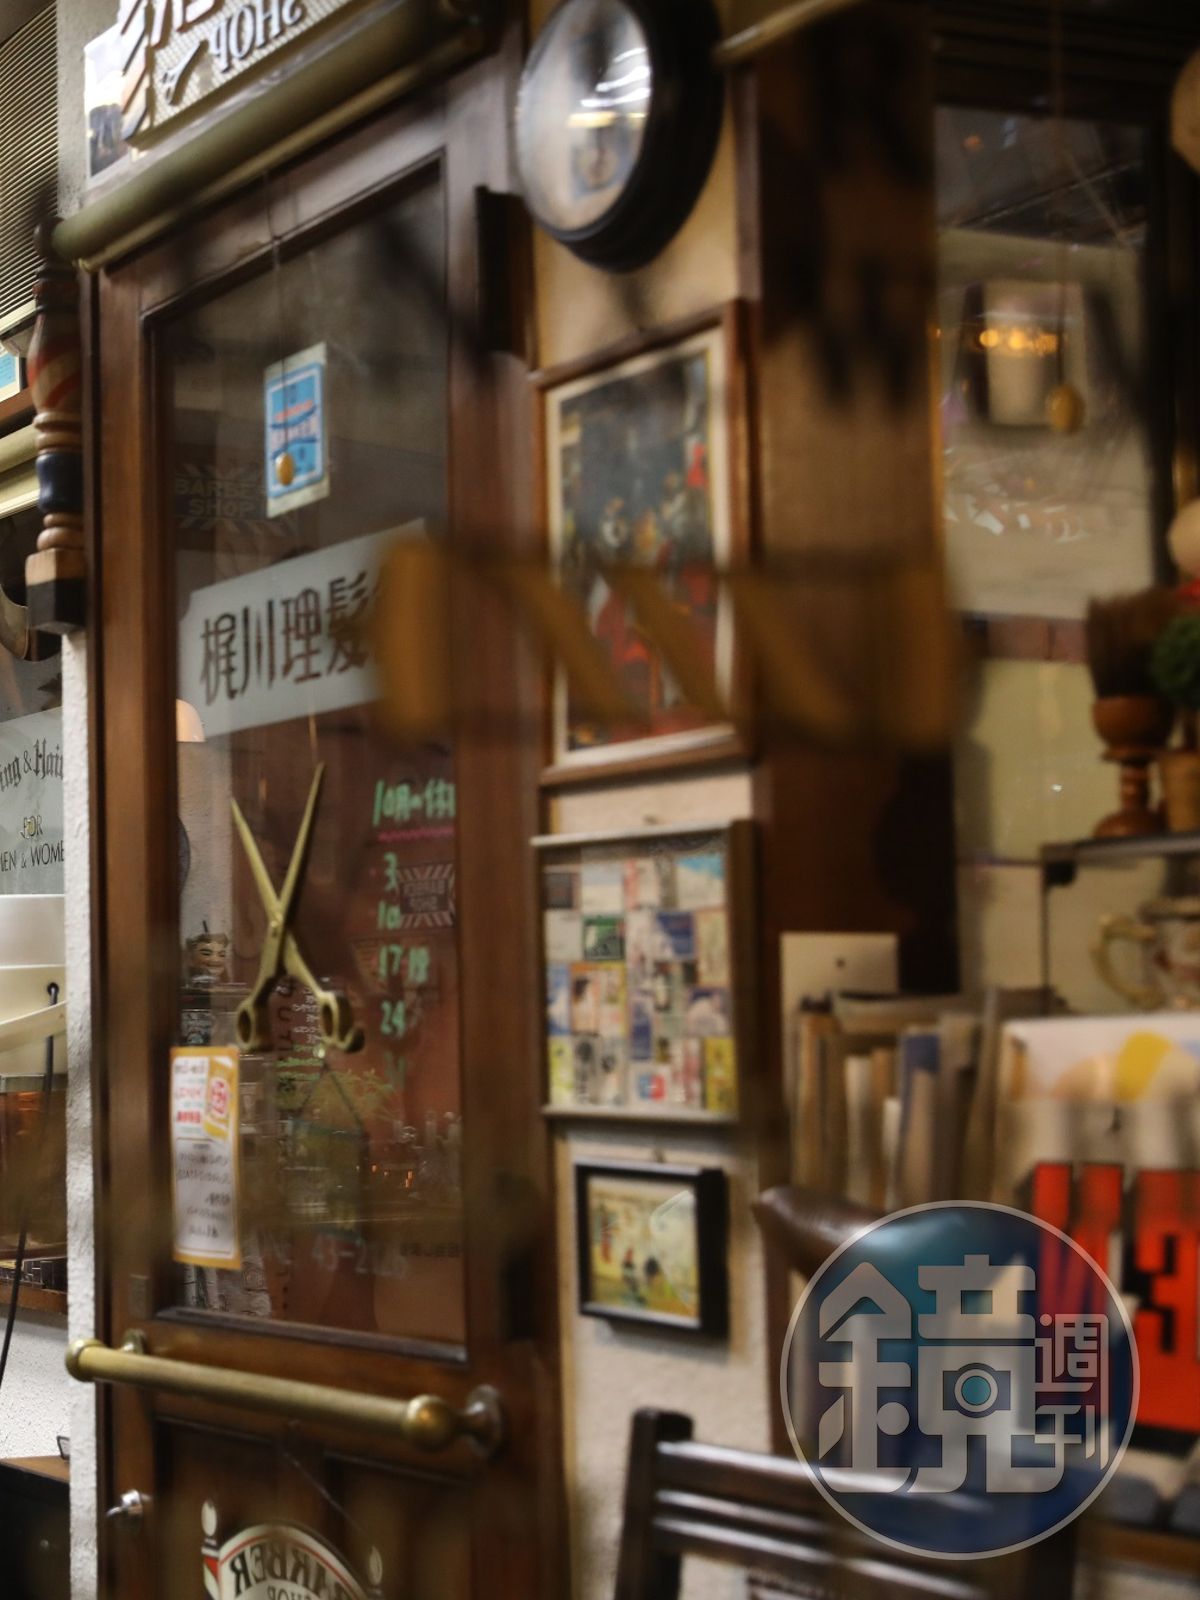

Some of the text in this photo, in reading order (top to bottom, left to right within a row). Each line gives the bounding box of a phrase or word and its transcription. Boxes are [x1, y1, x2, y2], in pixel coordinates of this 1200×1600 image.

[23, 750, 32, 774] &
[22, 815, 43, 838] FOR
[20, 854, 27, 869] &
